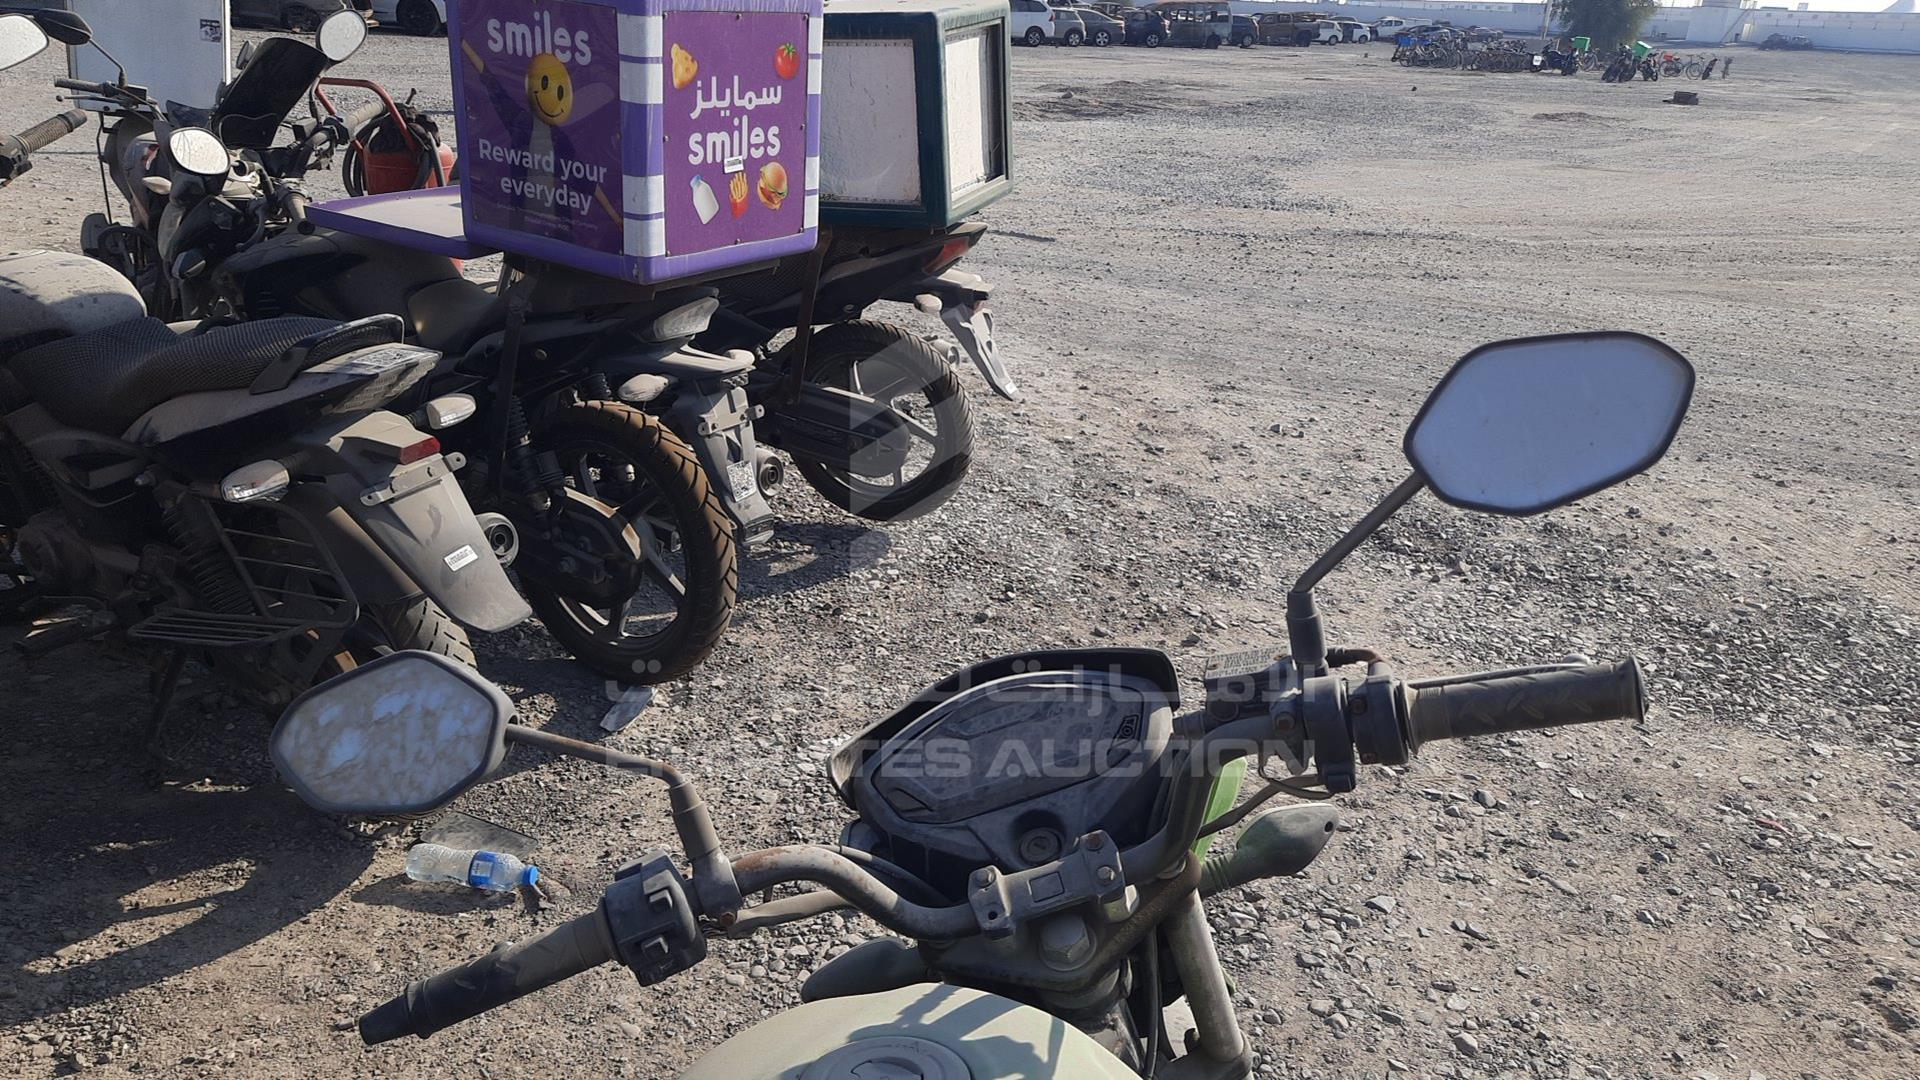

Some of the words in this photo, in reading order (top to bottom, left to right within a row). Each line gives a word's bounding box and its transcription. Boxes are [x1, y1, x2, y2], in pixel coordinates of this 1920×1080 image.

[487, 11, 592, 65] smiles
[690, 75, 782, 119] سمايلز
[479, 138, 554, 174] Reward
[560, 156, 607, 183] your
[688, 115, 781, 165] smiles
[501, 175, 593, 216] everyday
